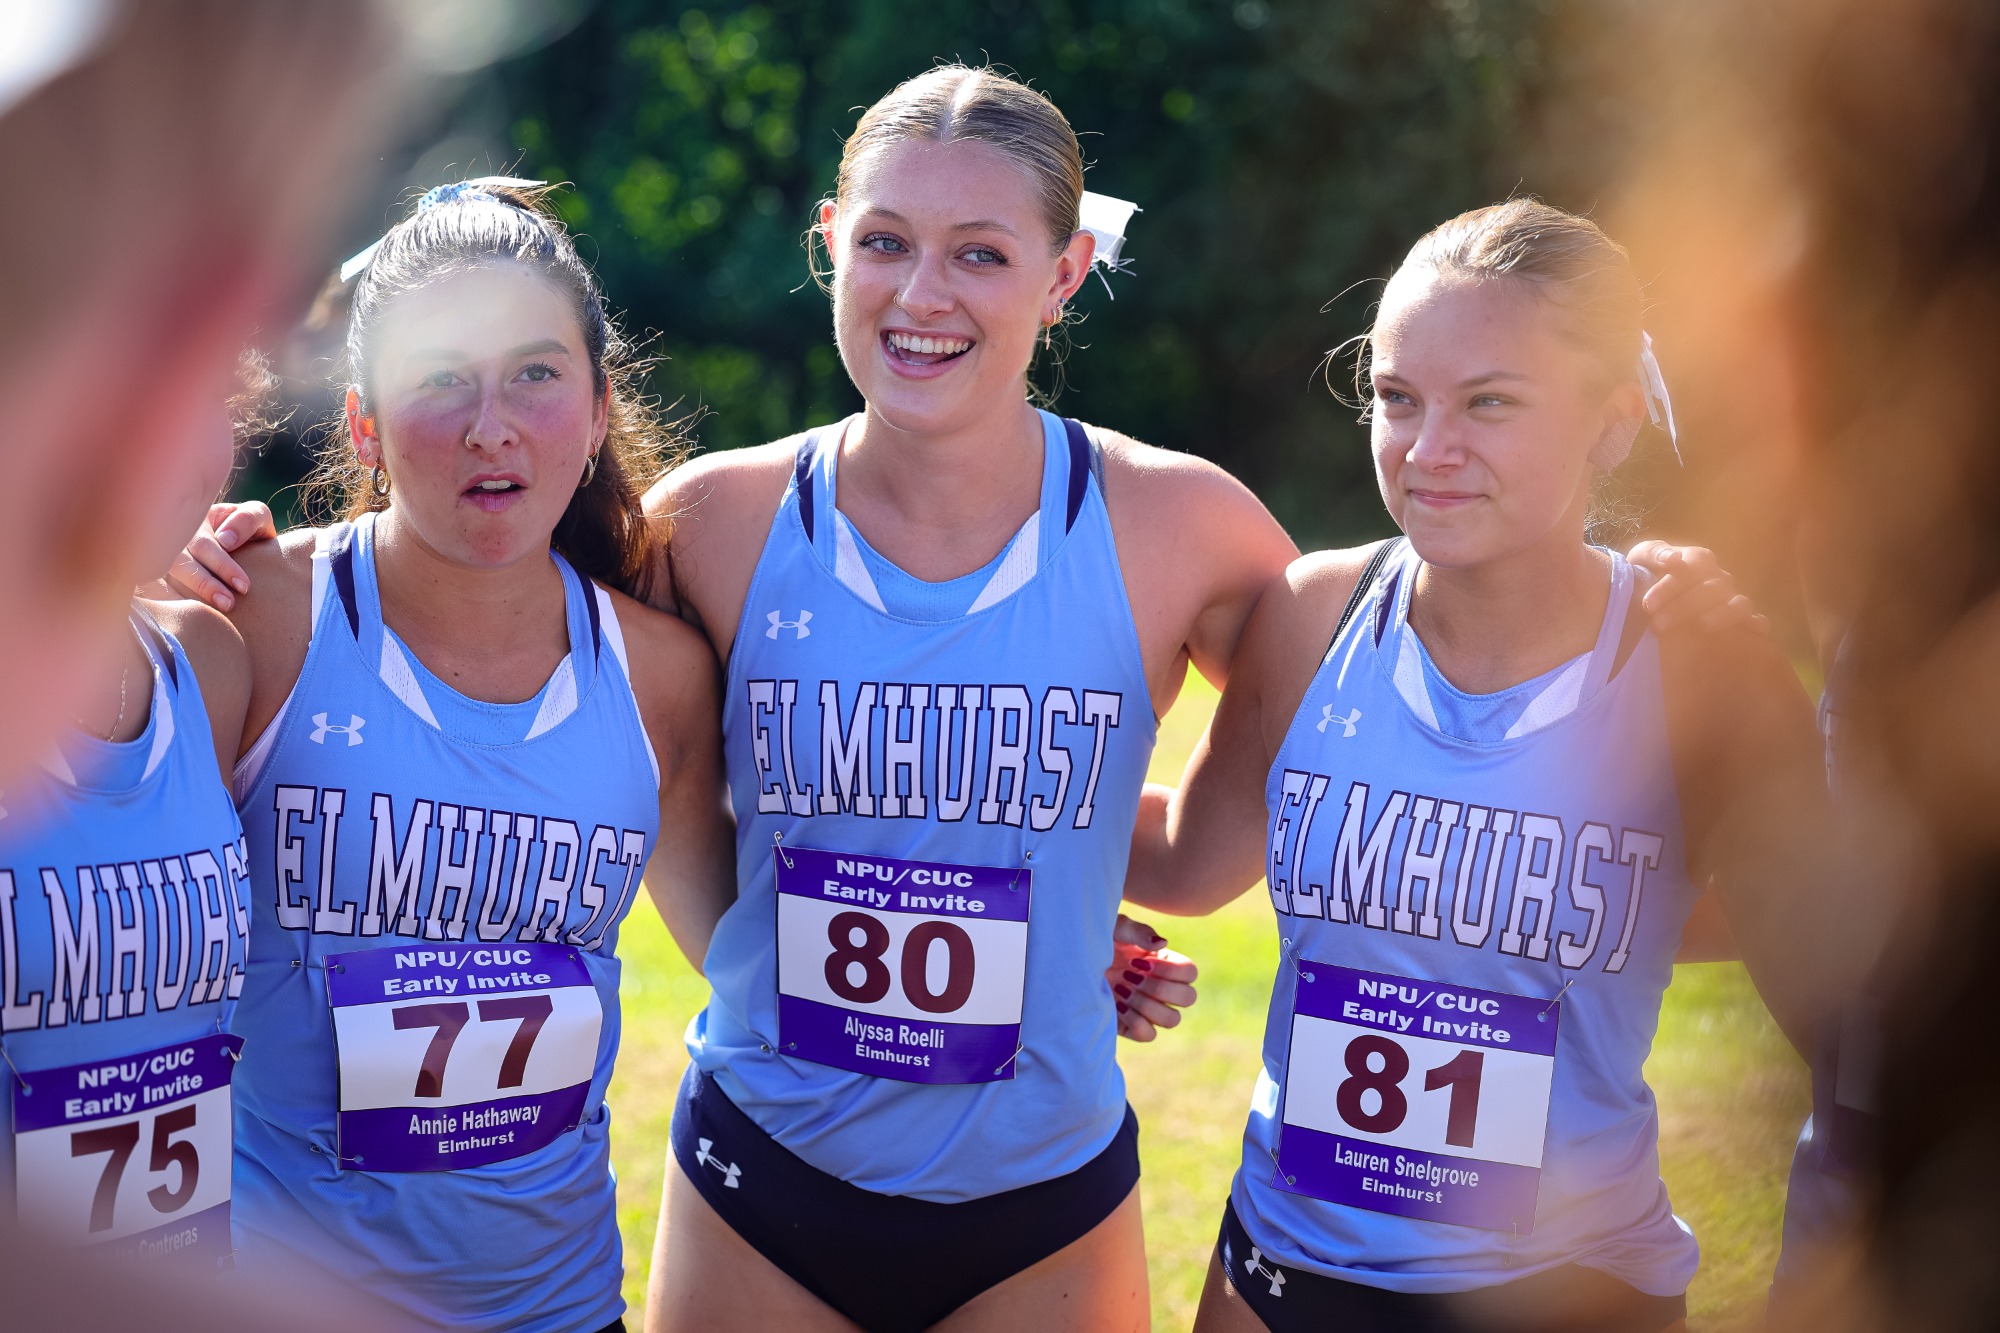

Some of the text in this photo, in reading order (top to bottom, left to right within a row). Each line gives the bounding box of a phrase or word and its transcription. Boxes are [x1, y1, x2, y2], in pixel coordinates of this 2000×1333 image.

[747, 679, 1123, 832] ELMHURST
[273, 784, 646, 952] ELMHURST
[836, 859, 973, 888] NPU/CUC
[1268, 768, 1665, 975] ELMHURST
[823, 880, 986, 914] Early Invite
[0, 833, 251, 1034] LMHURS
[394, 949, 532, 970] NPU/CUC
[824, 911, 975, 1013] 80
[383, 969, 551, 996] Early Invite
[1358, 978, 1500, 1017] NPU/CUC
[844, 1015, 945, 1050] Alyssa Roelli
[1342, 1000, 1511, 1043] Early Invite
[391, 995, 553, 1098] 77
[855, 1043, 930, 1068] Elmhurst
[78, 1048, 195, 1090] NPU/CUC
[64, 1072, 203, 1120] Early Invite
[1336, 1034, 1485, 1149] 81
[408, 1102, 541, 1135] Annie Hathaway
[438, 1131, 514, 1154] Elmhurst
[70, 1104, 200, 1234] 75
[1335, 1142, 1479, 1188] Lauren Snelgrove
[1361, 1176, 1443, 1204] Elmhurst
[138, 1225, 199, 1260] Contreras
